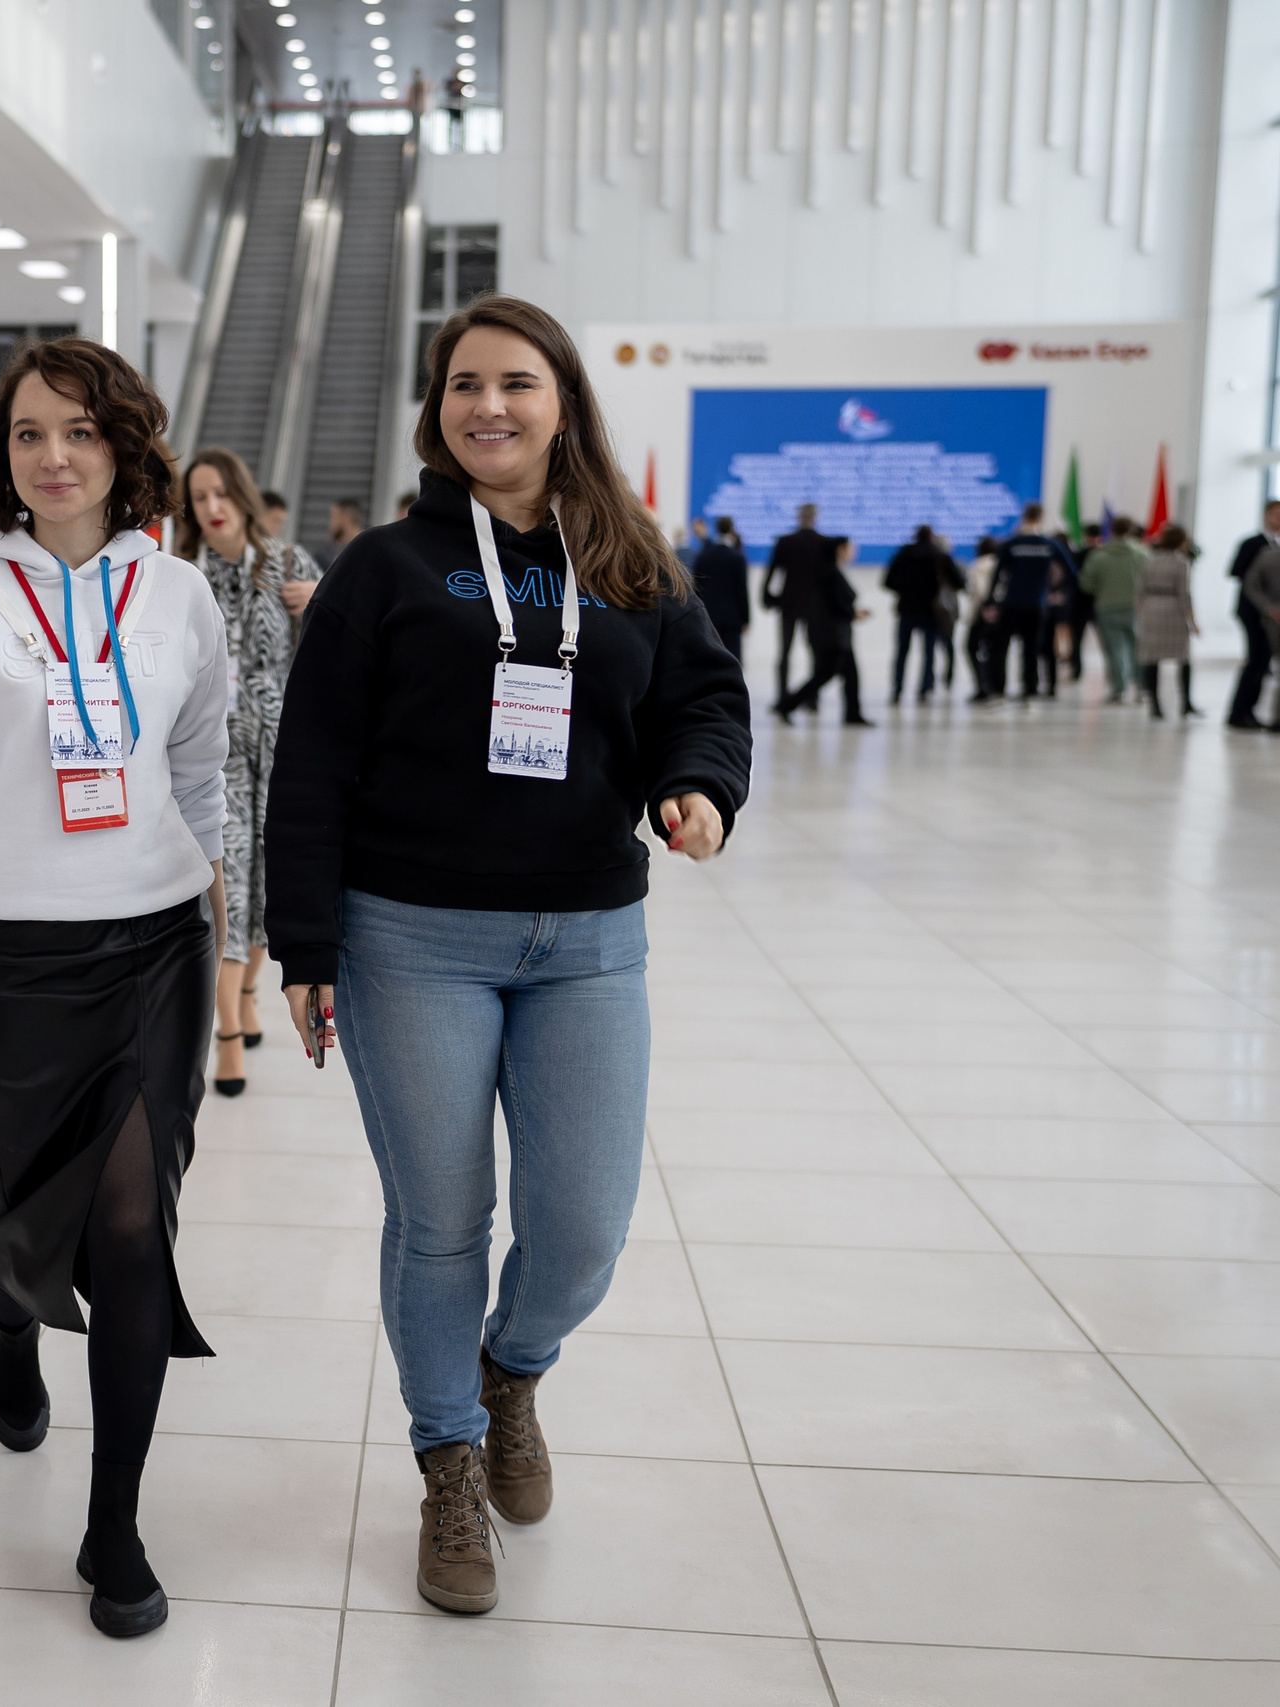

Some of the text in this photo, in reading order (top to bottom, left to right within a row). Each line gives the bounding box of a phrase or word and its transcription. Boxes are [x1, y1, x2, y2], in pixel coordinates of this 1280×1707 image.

[446, 567, 607, 608] SML
[530, 682, 564, 690] СПЕЦИАЛИСТ
[502, 701, 561, 714] ОРГКОМИТЕТ
